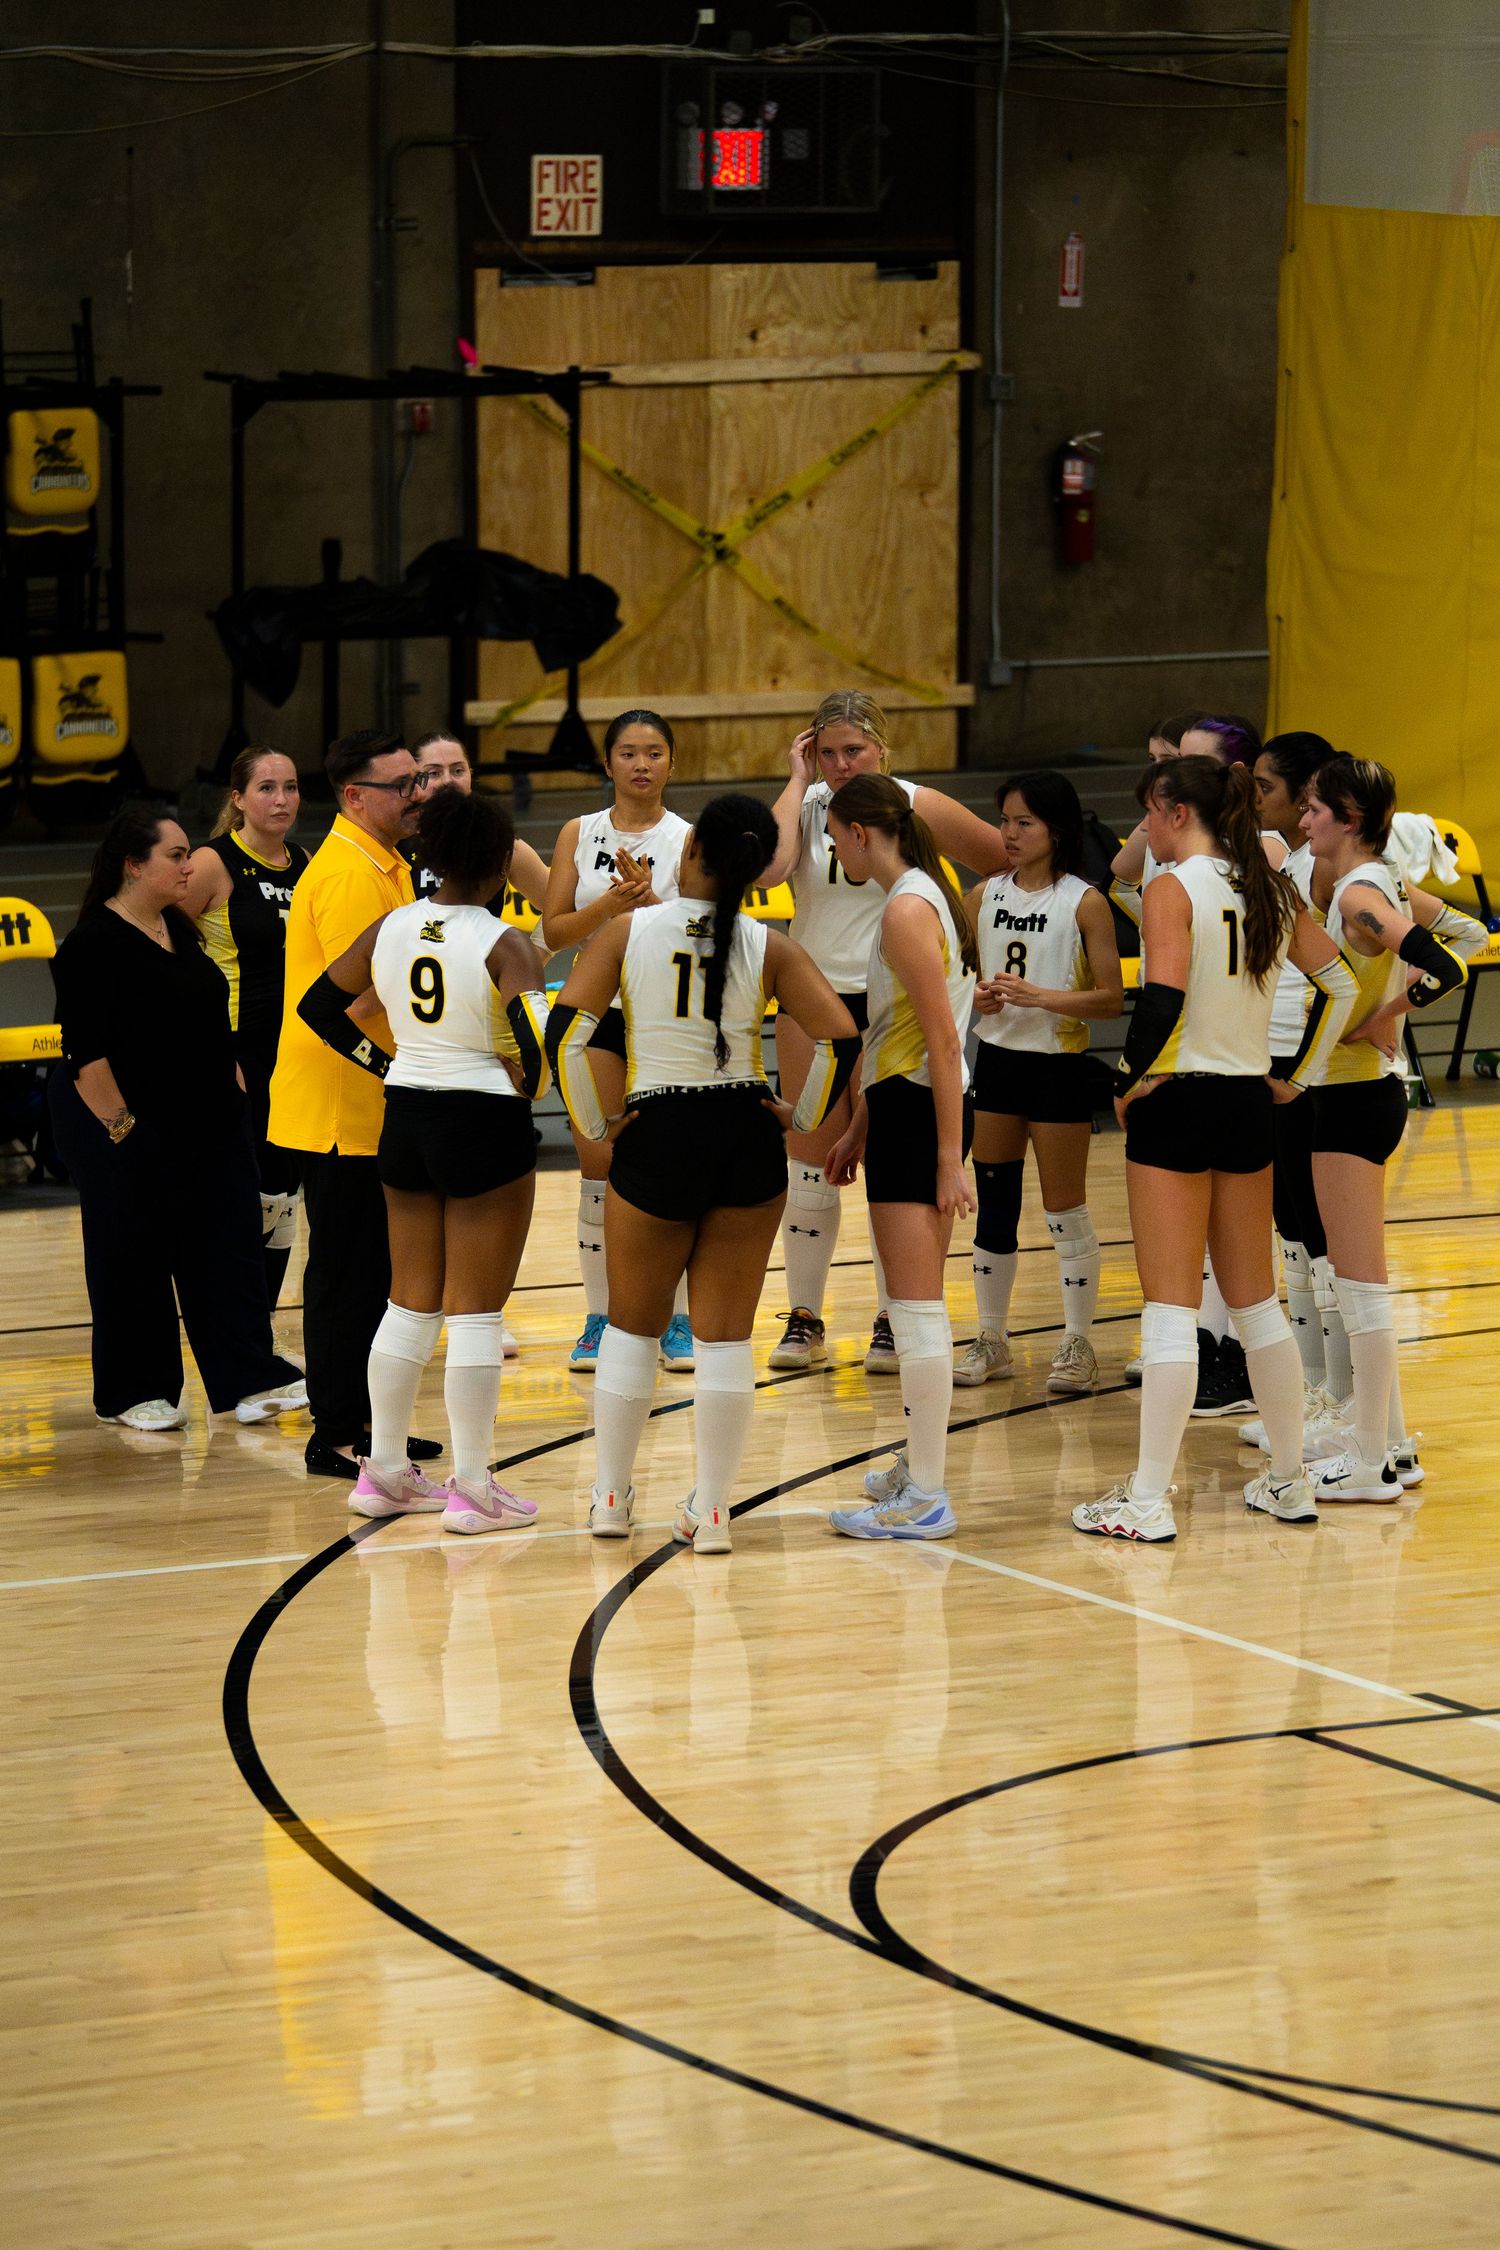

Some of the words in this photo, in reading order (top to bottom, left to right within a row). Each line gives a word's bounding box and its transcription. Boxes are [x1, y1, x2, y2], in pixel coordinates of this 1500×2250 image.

[537, 160, 598, 193] FIRE
[536, 197, 598, 231] EXIT
[993, 908, 1048, 932] Pratt
[1005, 941, 1027, 979] 8
[410, 956, 445, 1024] 9
